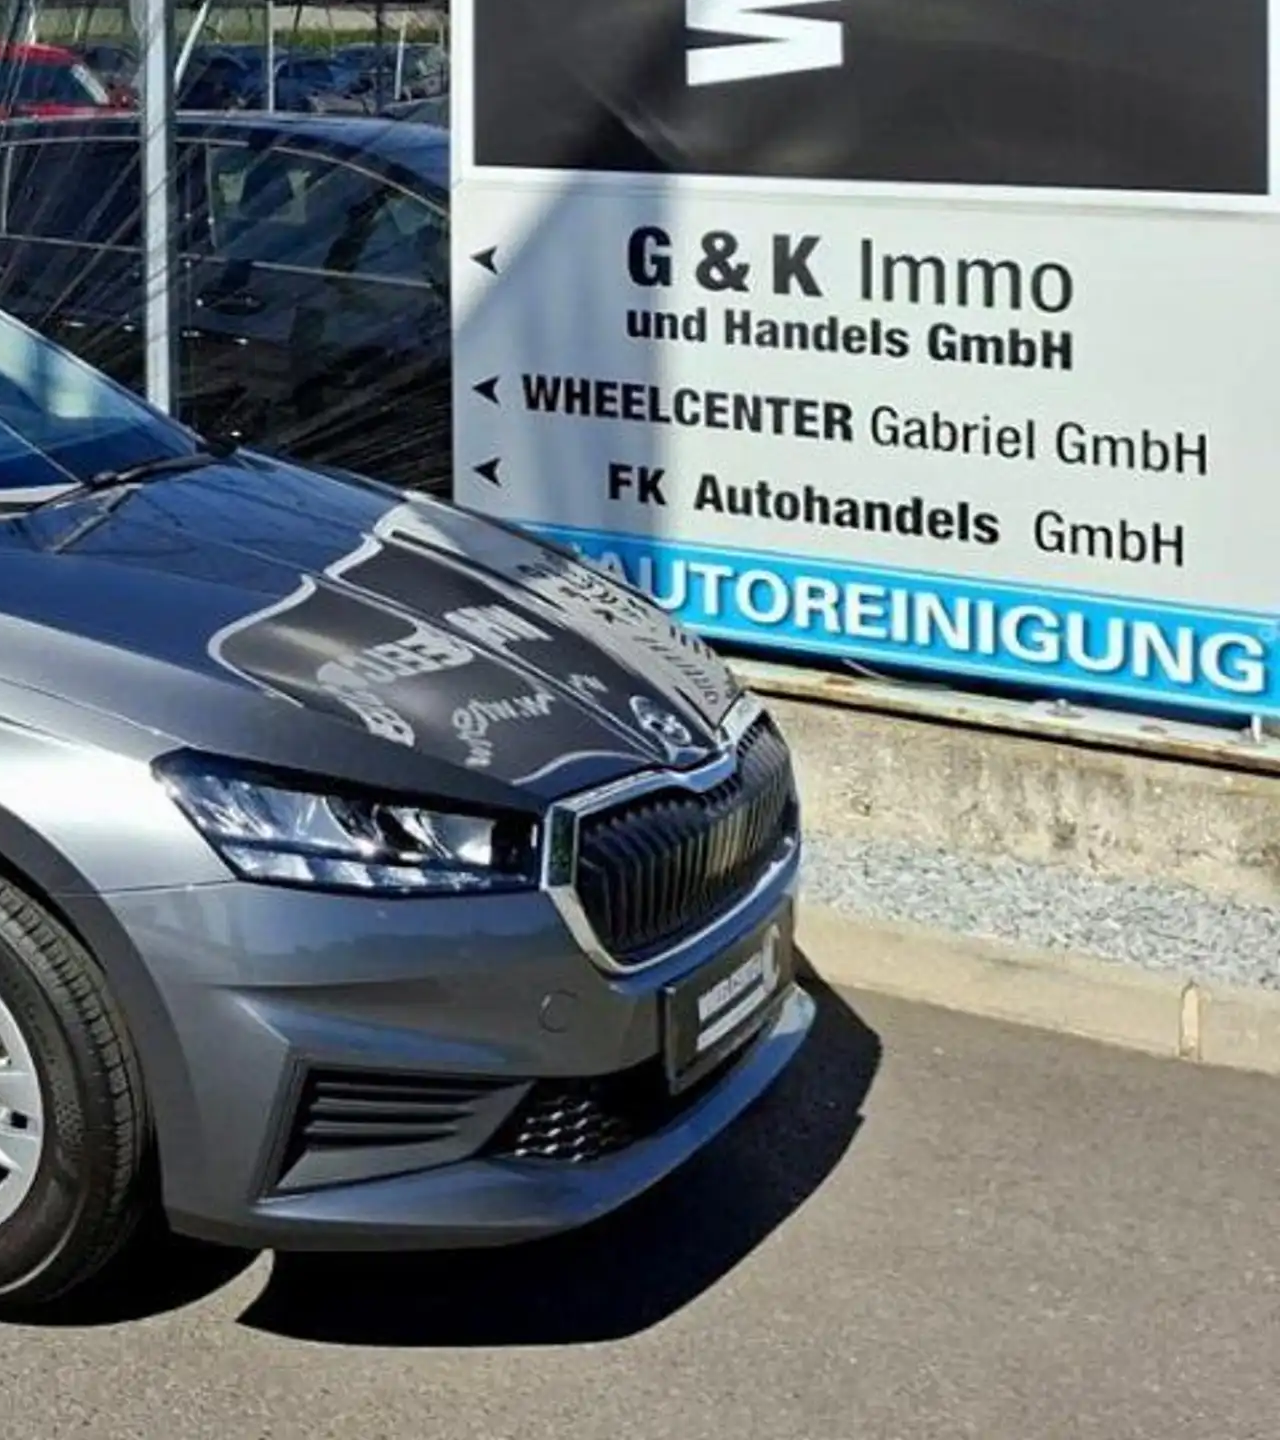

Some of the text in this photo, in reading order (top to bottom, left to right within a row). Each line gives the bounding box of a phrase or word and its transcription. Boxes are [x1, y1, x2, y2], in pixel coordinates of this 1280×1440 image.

[627, 224, 1072, 313] G & K Immo
[626, 307, 1072, 371] und Handels GmbH
[521, 372, 1207, 476] WHEELCENTER Gabriel GmbH
[607, 460, 1184, 567] FK Autohandels GmbH
